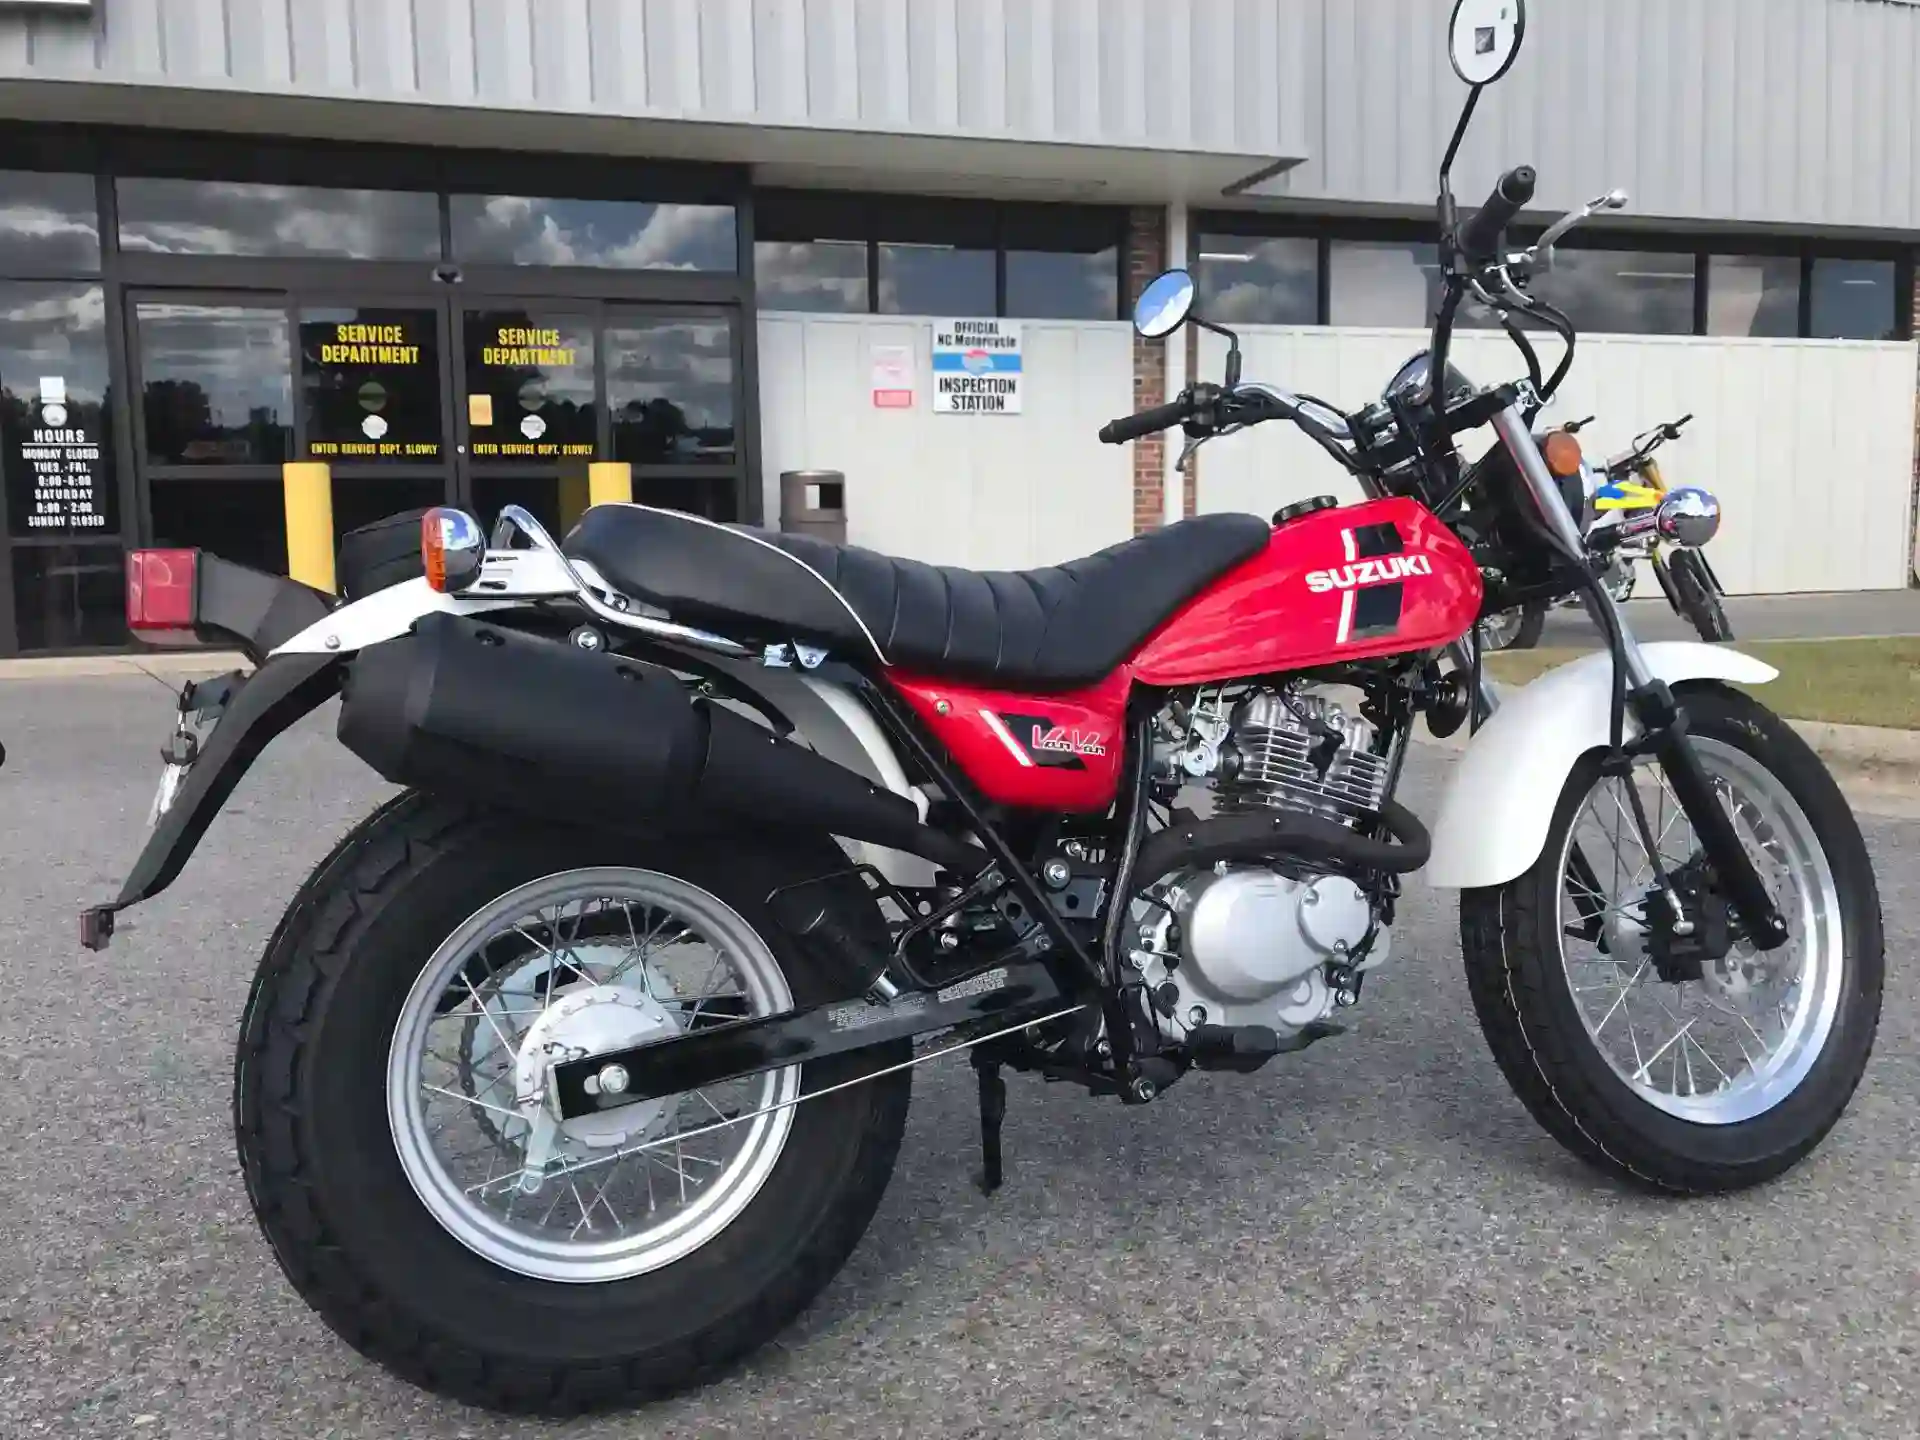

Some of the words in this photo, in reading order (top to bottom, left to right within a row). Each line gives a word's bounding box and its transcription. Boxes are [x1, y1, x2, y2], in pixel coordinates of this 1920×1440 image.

[337, 324, 403, 344] SERVICE
[954, 321, 999, 334] OFFICIAL
[497, 327, 561, 346] SERVICE
[937, 333, 952, 346] NC
[954, 334, 1016, 349] Motorcycle
[322, 344, 419, 364] DEPARTMENT
[483, 347, 577, 366] DEPARTMENT
[939, 377, 1016, 394] INSPECTION
[951, 394, 1005, 411] STATION
[33, 429, 85, 443] HOURS
[22, 448, 61, 459] MONDAY
[65, 448, 99, 459] CLOSED
[311, 443, 338, 454] ENTER
[341, 443, 376, 454] SERVICE
[379, 443, 403, 455] DEPT.
[405, 443, 438, 455] SLOWLY
[473, 443, 498, 455] ENTER
[501, 444, 535, 455] SERVICE
[562, 444, 594, 456] SLOWLY
[34, 488, 93, 500] SATURDAY
[28, 515, 65, 527] SUNDAY
[70, 515, 105, 527] CLOSED
[1305, 554, 1433, 593] SUZUKI
